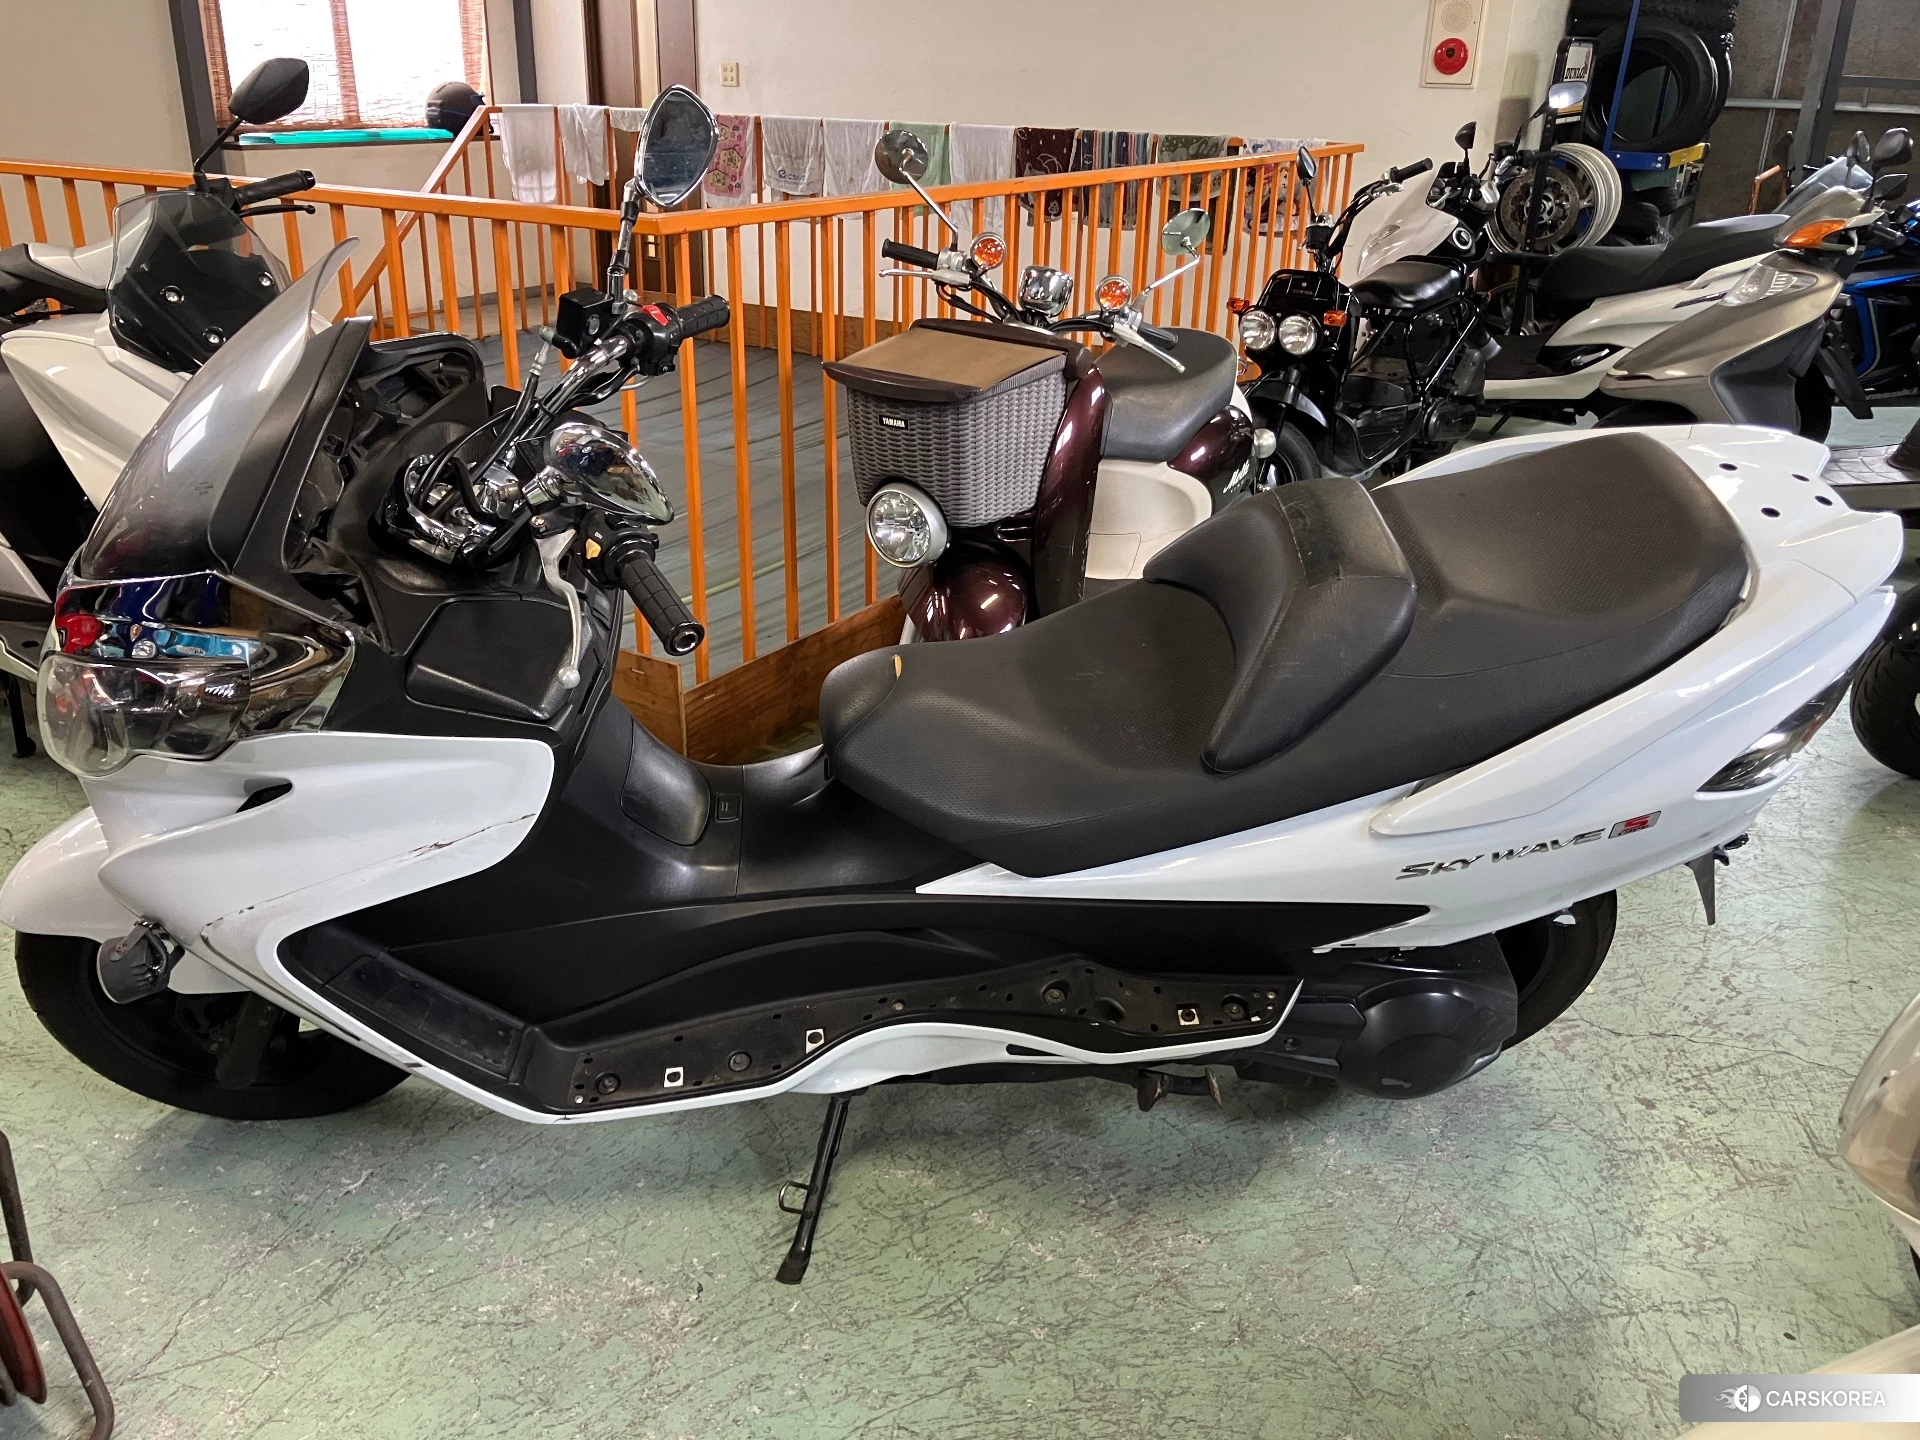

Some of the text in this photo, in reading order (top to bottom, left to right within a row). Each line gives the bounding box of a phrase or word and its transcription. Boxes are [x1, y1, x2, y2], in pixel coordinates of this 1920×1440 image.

[882, 417, 906, 428] YAMAHA
[1395, 853, 1485, 881] SKY
[1491, 828, 1606, 863] WAVE
